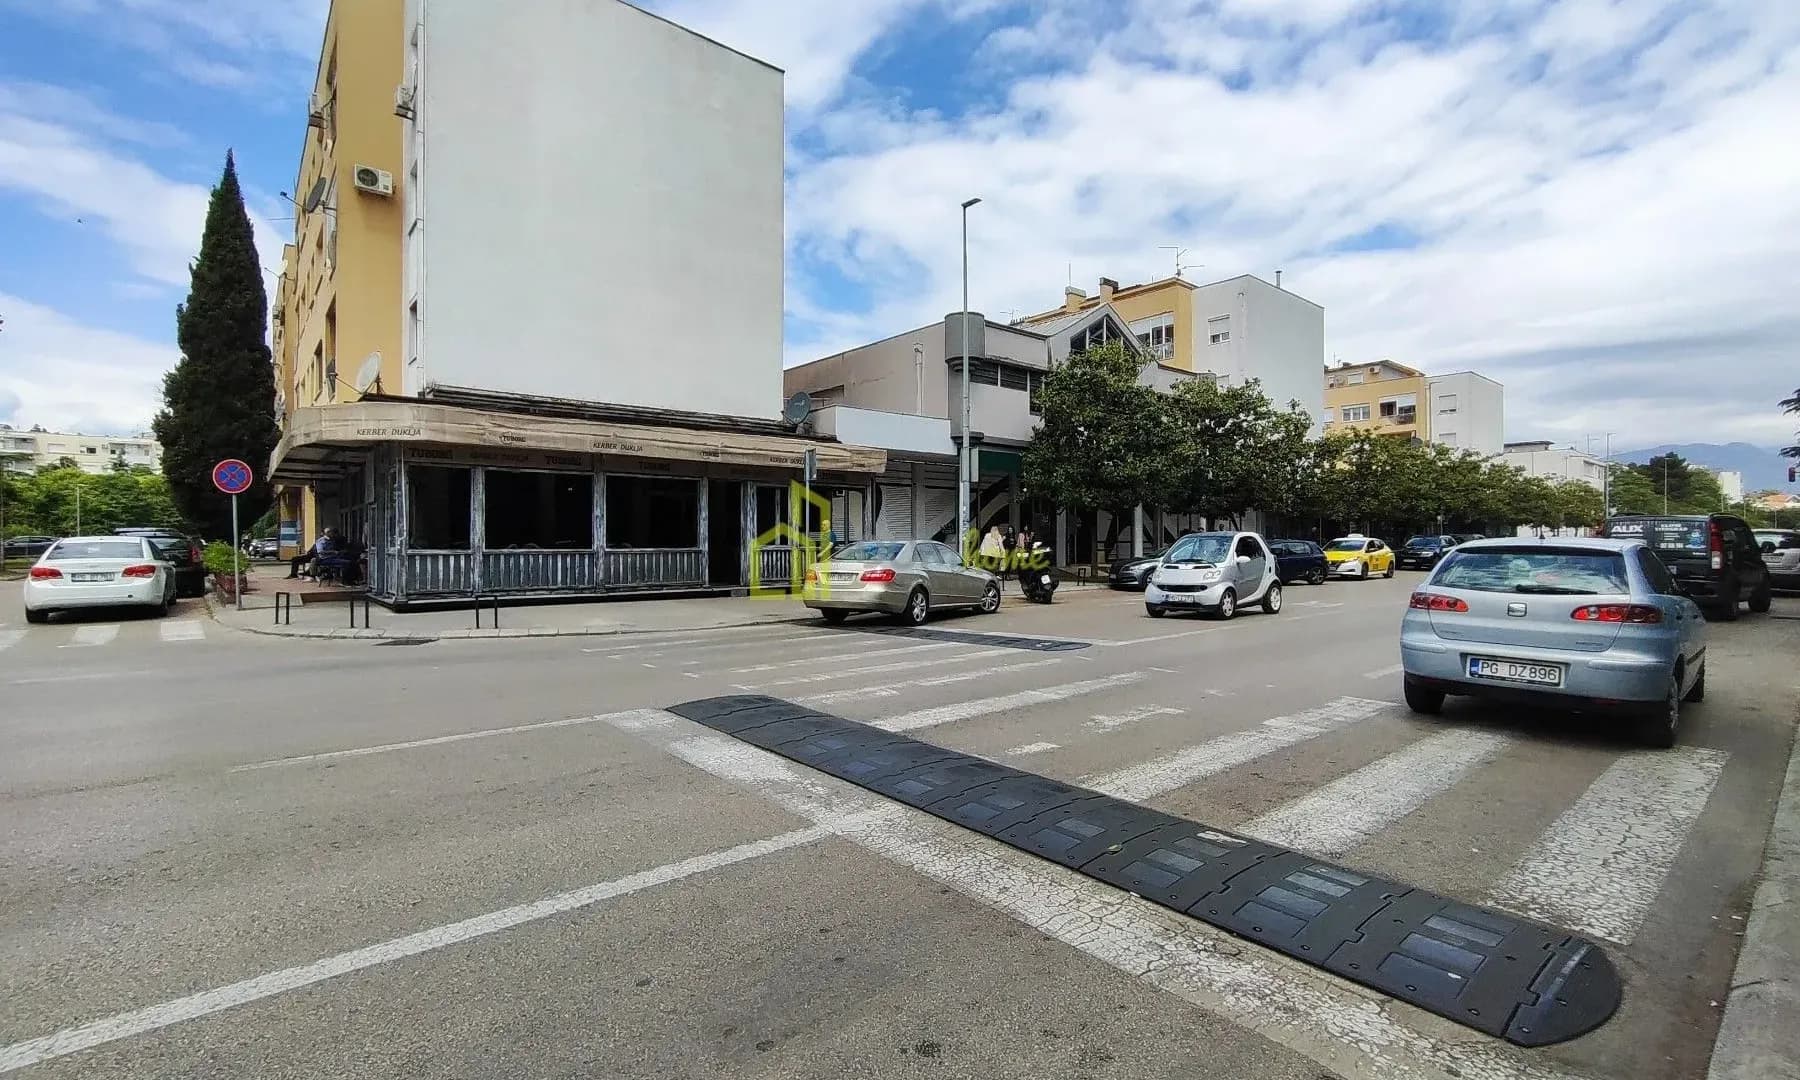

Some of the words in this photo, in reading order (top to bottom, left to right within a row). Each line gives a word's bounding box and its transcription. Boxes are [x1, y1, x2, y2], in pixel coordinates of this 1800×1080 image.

[356, 428, 387, 436] KERBER
[391, 428, 421, 437] DUKLJA
[1480, 661, 1499, 675] PG
[1508, 666, 1558, 682] DZ896
